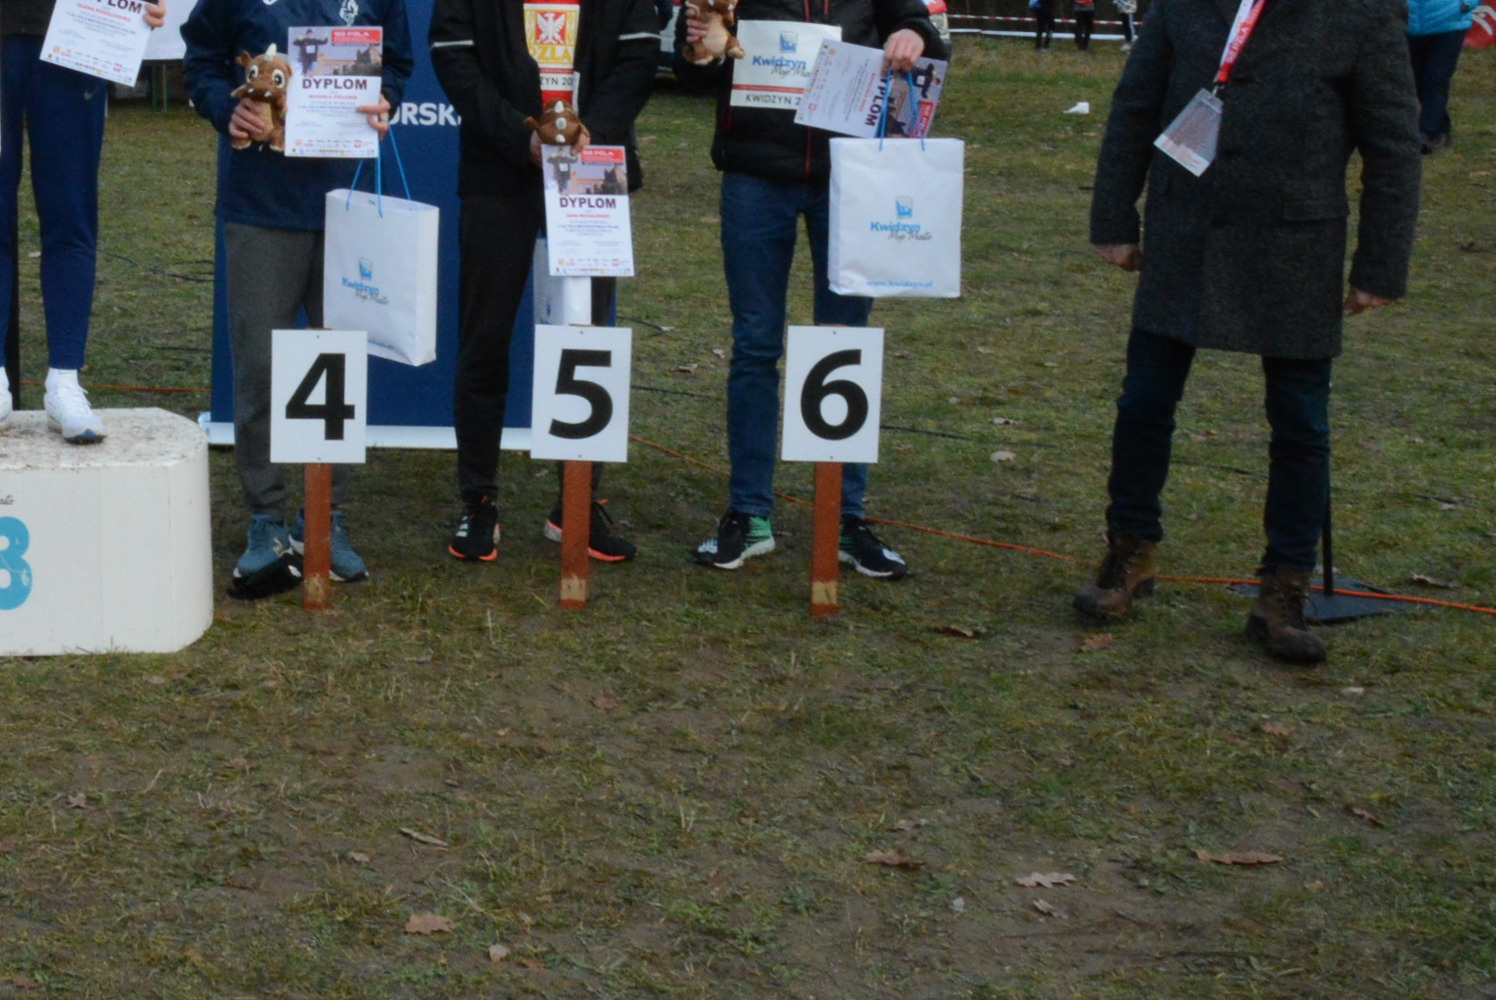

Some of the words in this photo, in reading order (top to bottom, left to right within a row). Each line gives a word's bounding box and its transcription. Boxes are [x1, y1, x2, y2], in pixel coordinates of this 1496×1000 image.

[752, 55, 806, 70] Kwidzyn
[302, 78, 368, 90] DYPLOM
[746, 93, 791, 104] KWIDZYN
[559, 197, 617, 209] DYPLOM
[870, 221, 921, 234] Kwidzyn
[285, 352, 356, 441] 4
[548, 348, 613, 440] 5
[800, 348, 869, 441] 6
